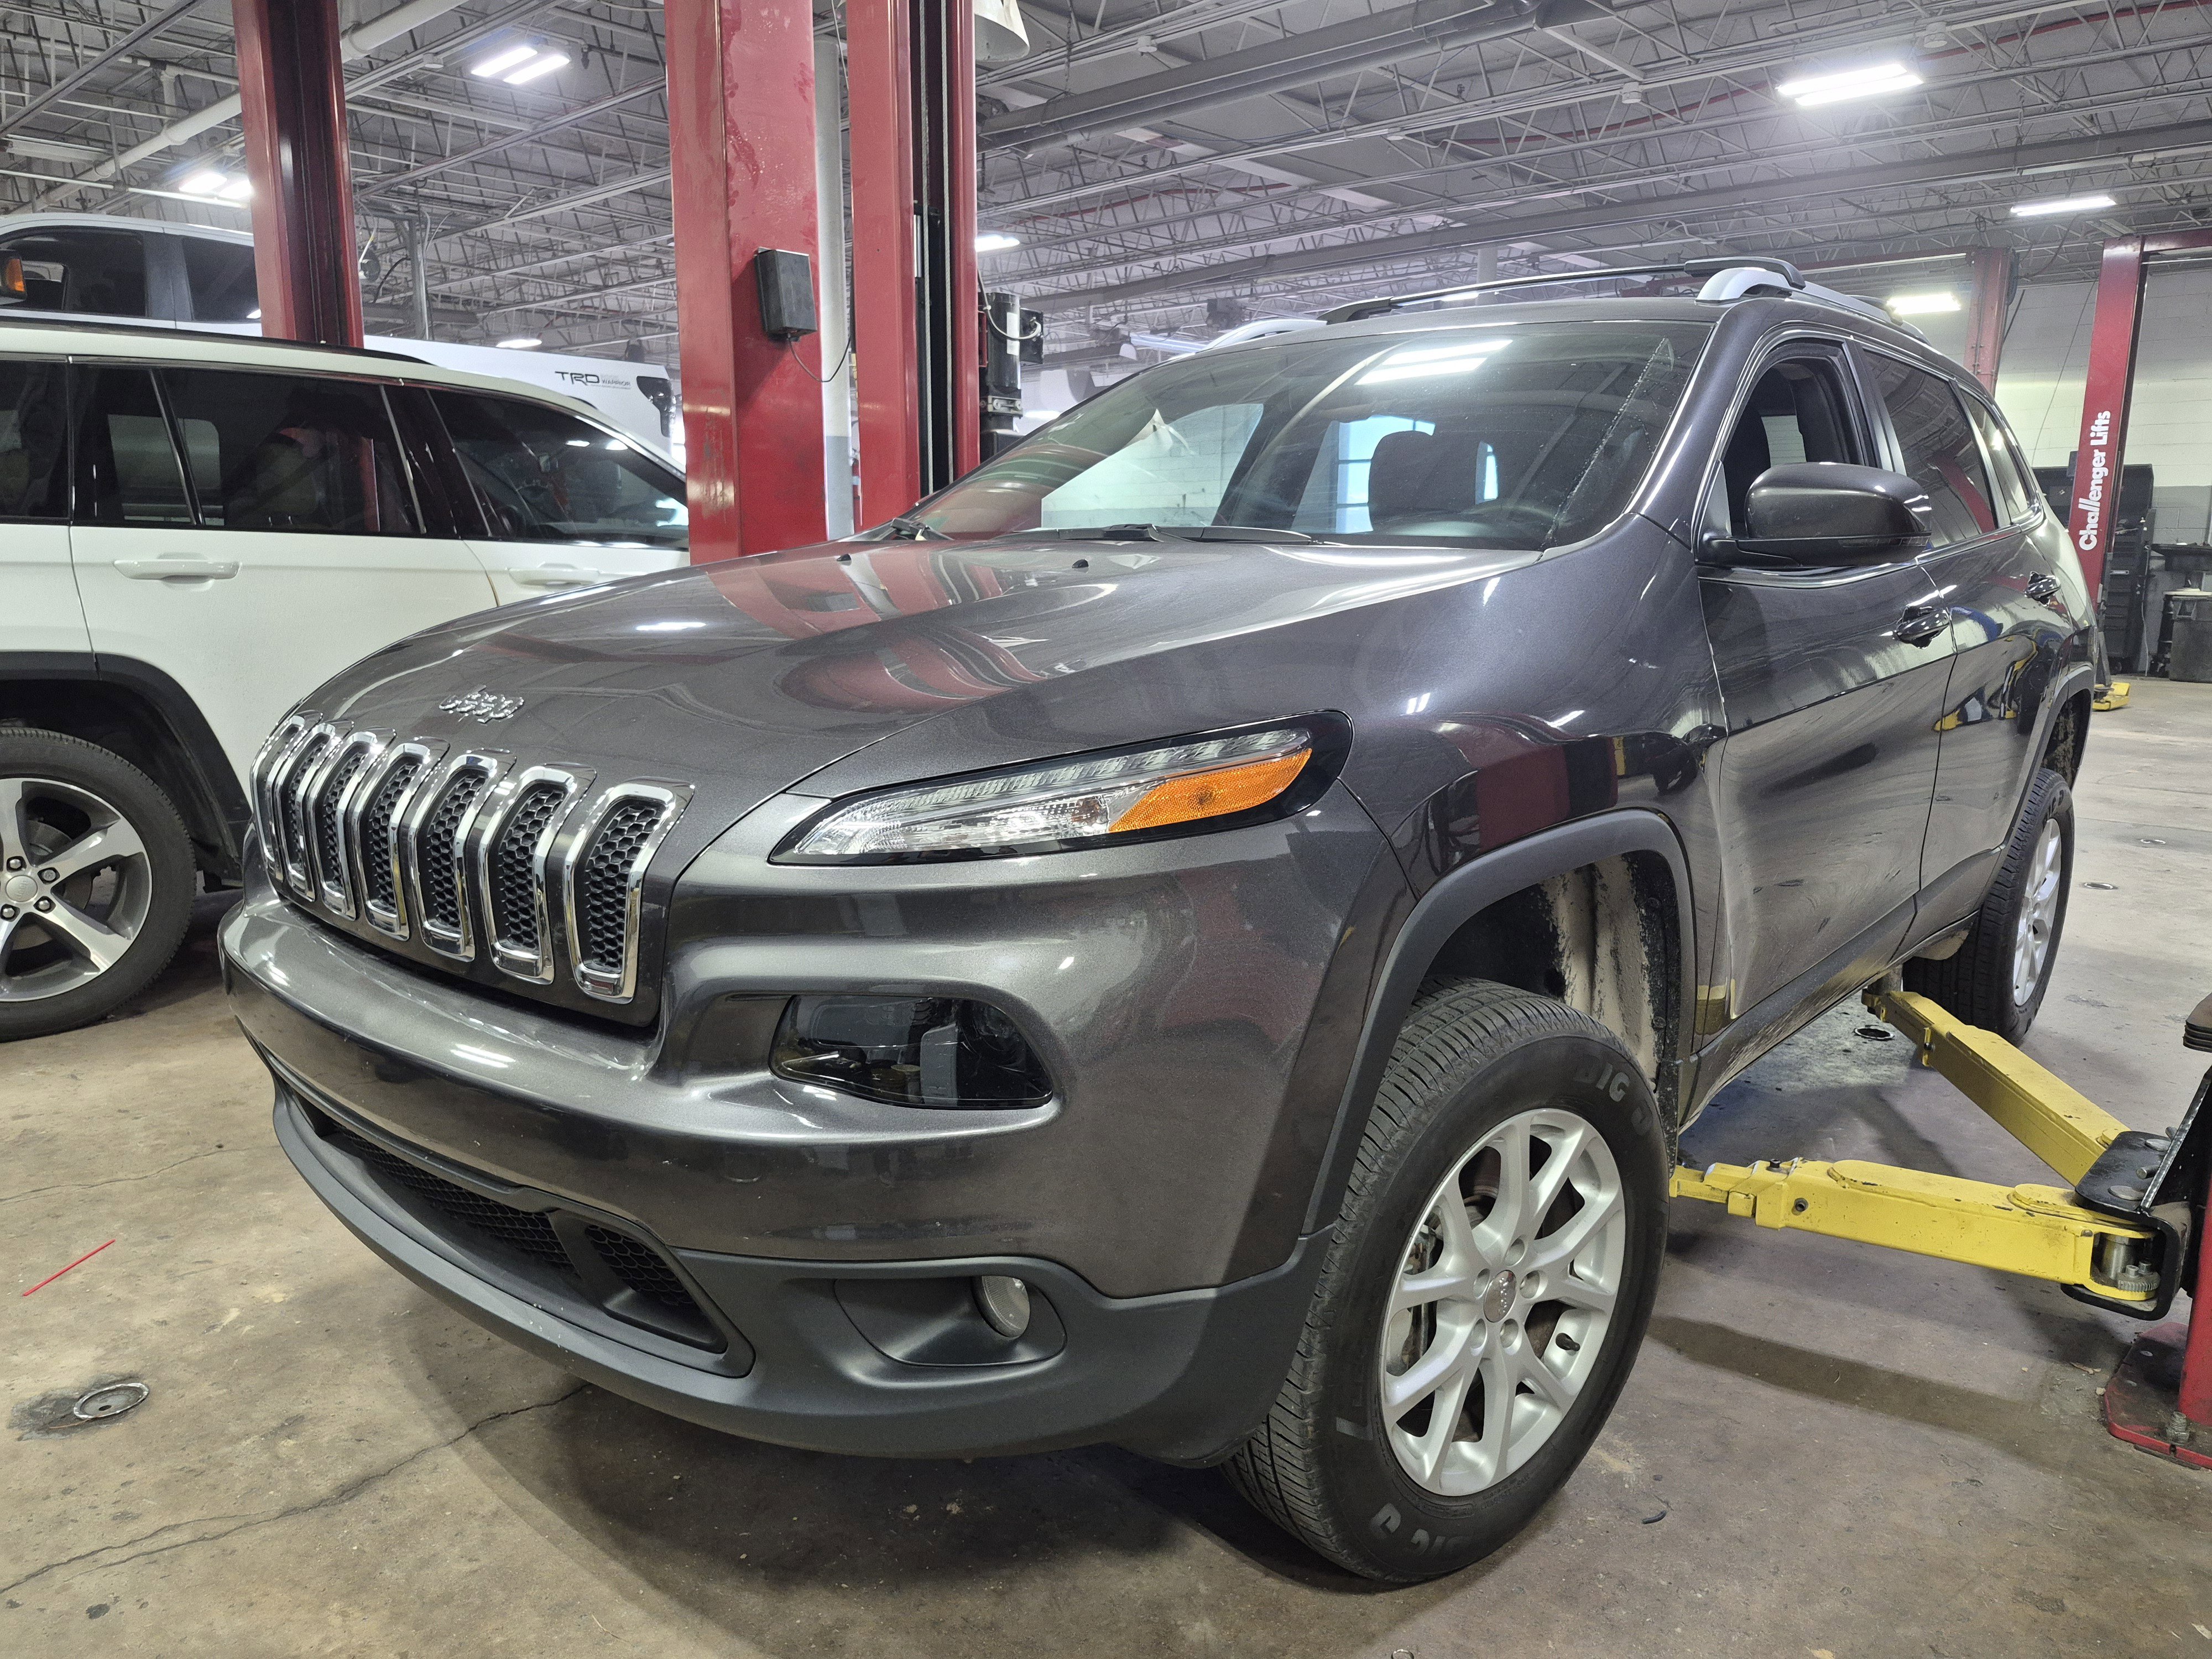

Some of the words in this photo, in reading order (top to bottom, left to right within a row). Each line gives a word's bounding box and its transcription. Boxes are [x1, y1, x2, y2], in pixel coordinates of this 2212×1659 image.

[555, 371, 599, 385] TRD
[2090, 410, 2110, 446] Lifts
[2079, 450, 2108, 550] Challenger
